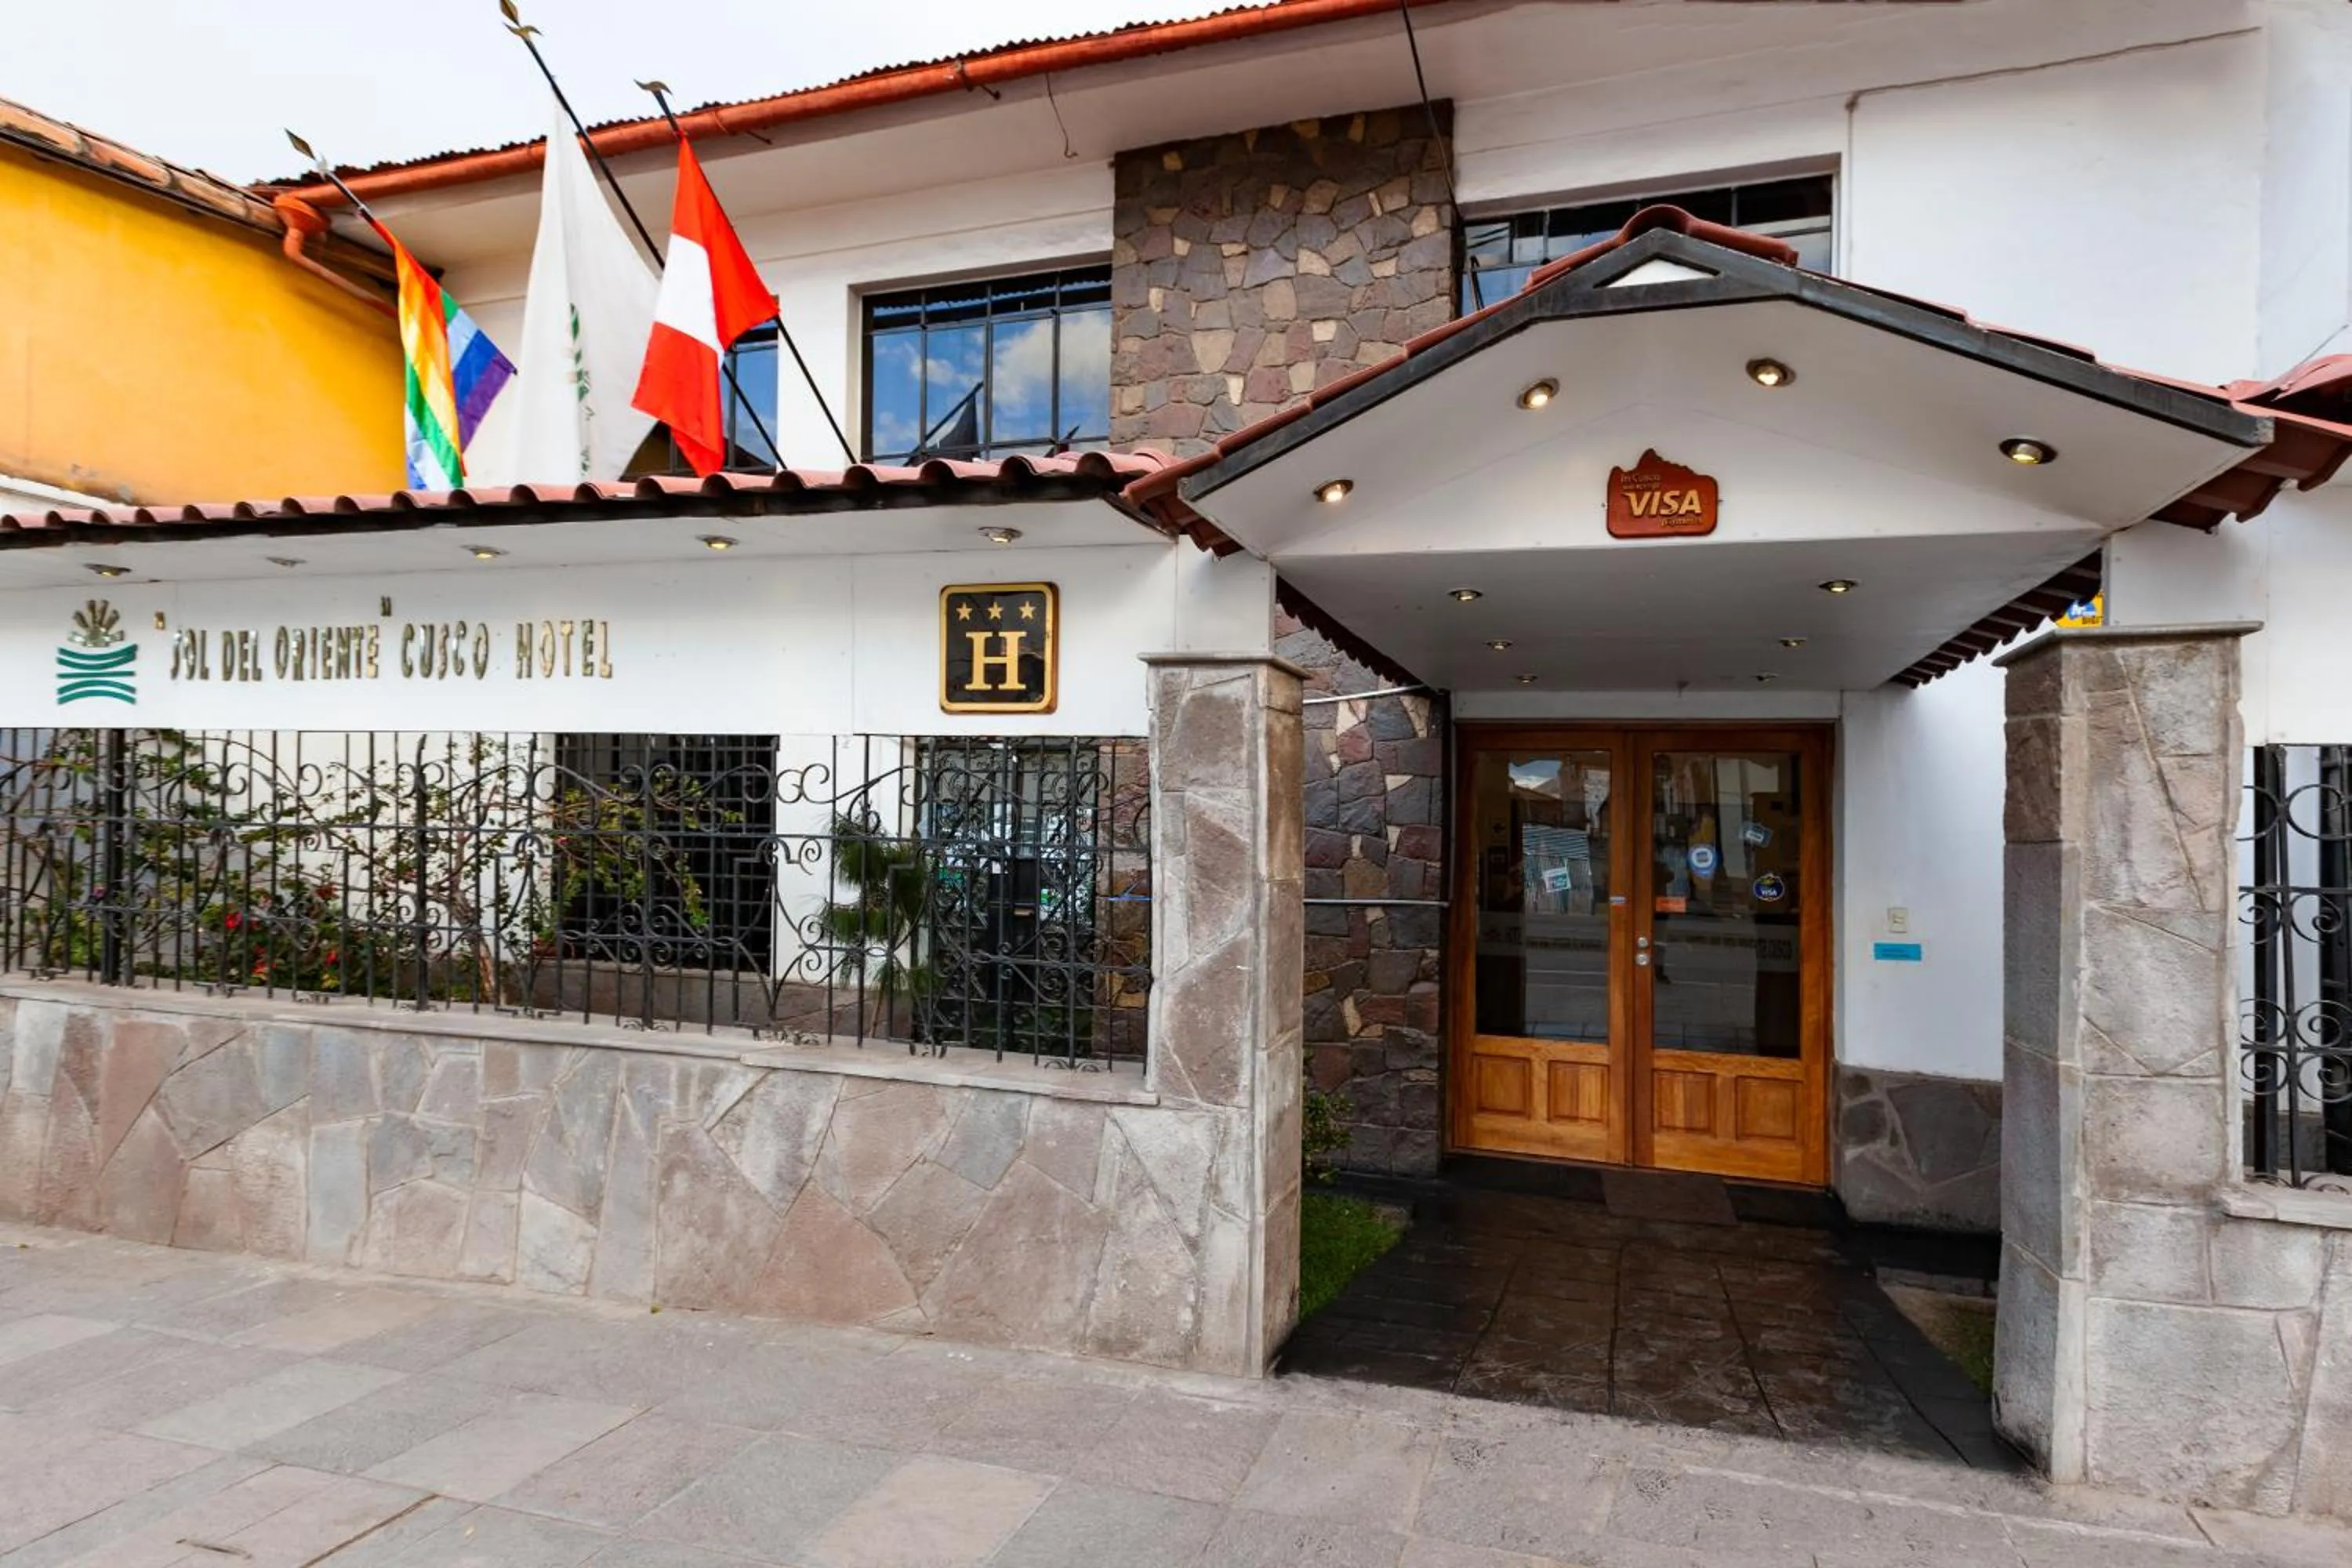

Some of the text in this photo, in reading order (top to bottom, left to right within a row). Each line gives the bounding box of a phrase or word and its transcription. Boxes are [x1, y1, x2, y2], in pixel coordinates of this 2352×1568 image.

[1622, 490, 1702, 516] VISA
[170, 619, 613, 681] SOL DEL ORIENTE CUSCO HOTEL
[964, 631, 1027, 690] H
